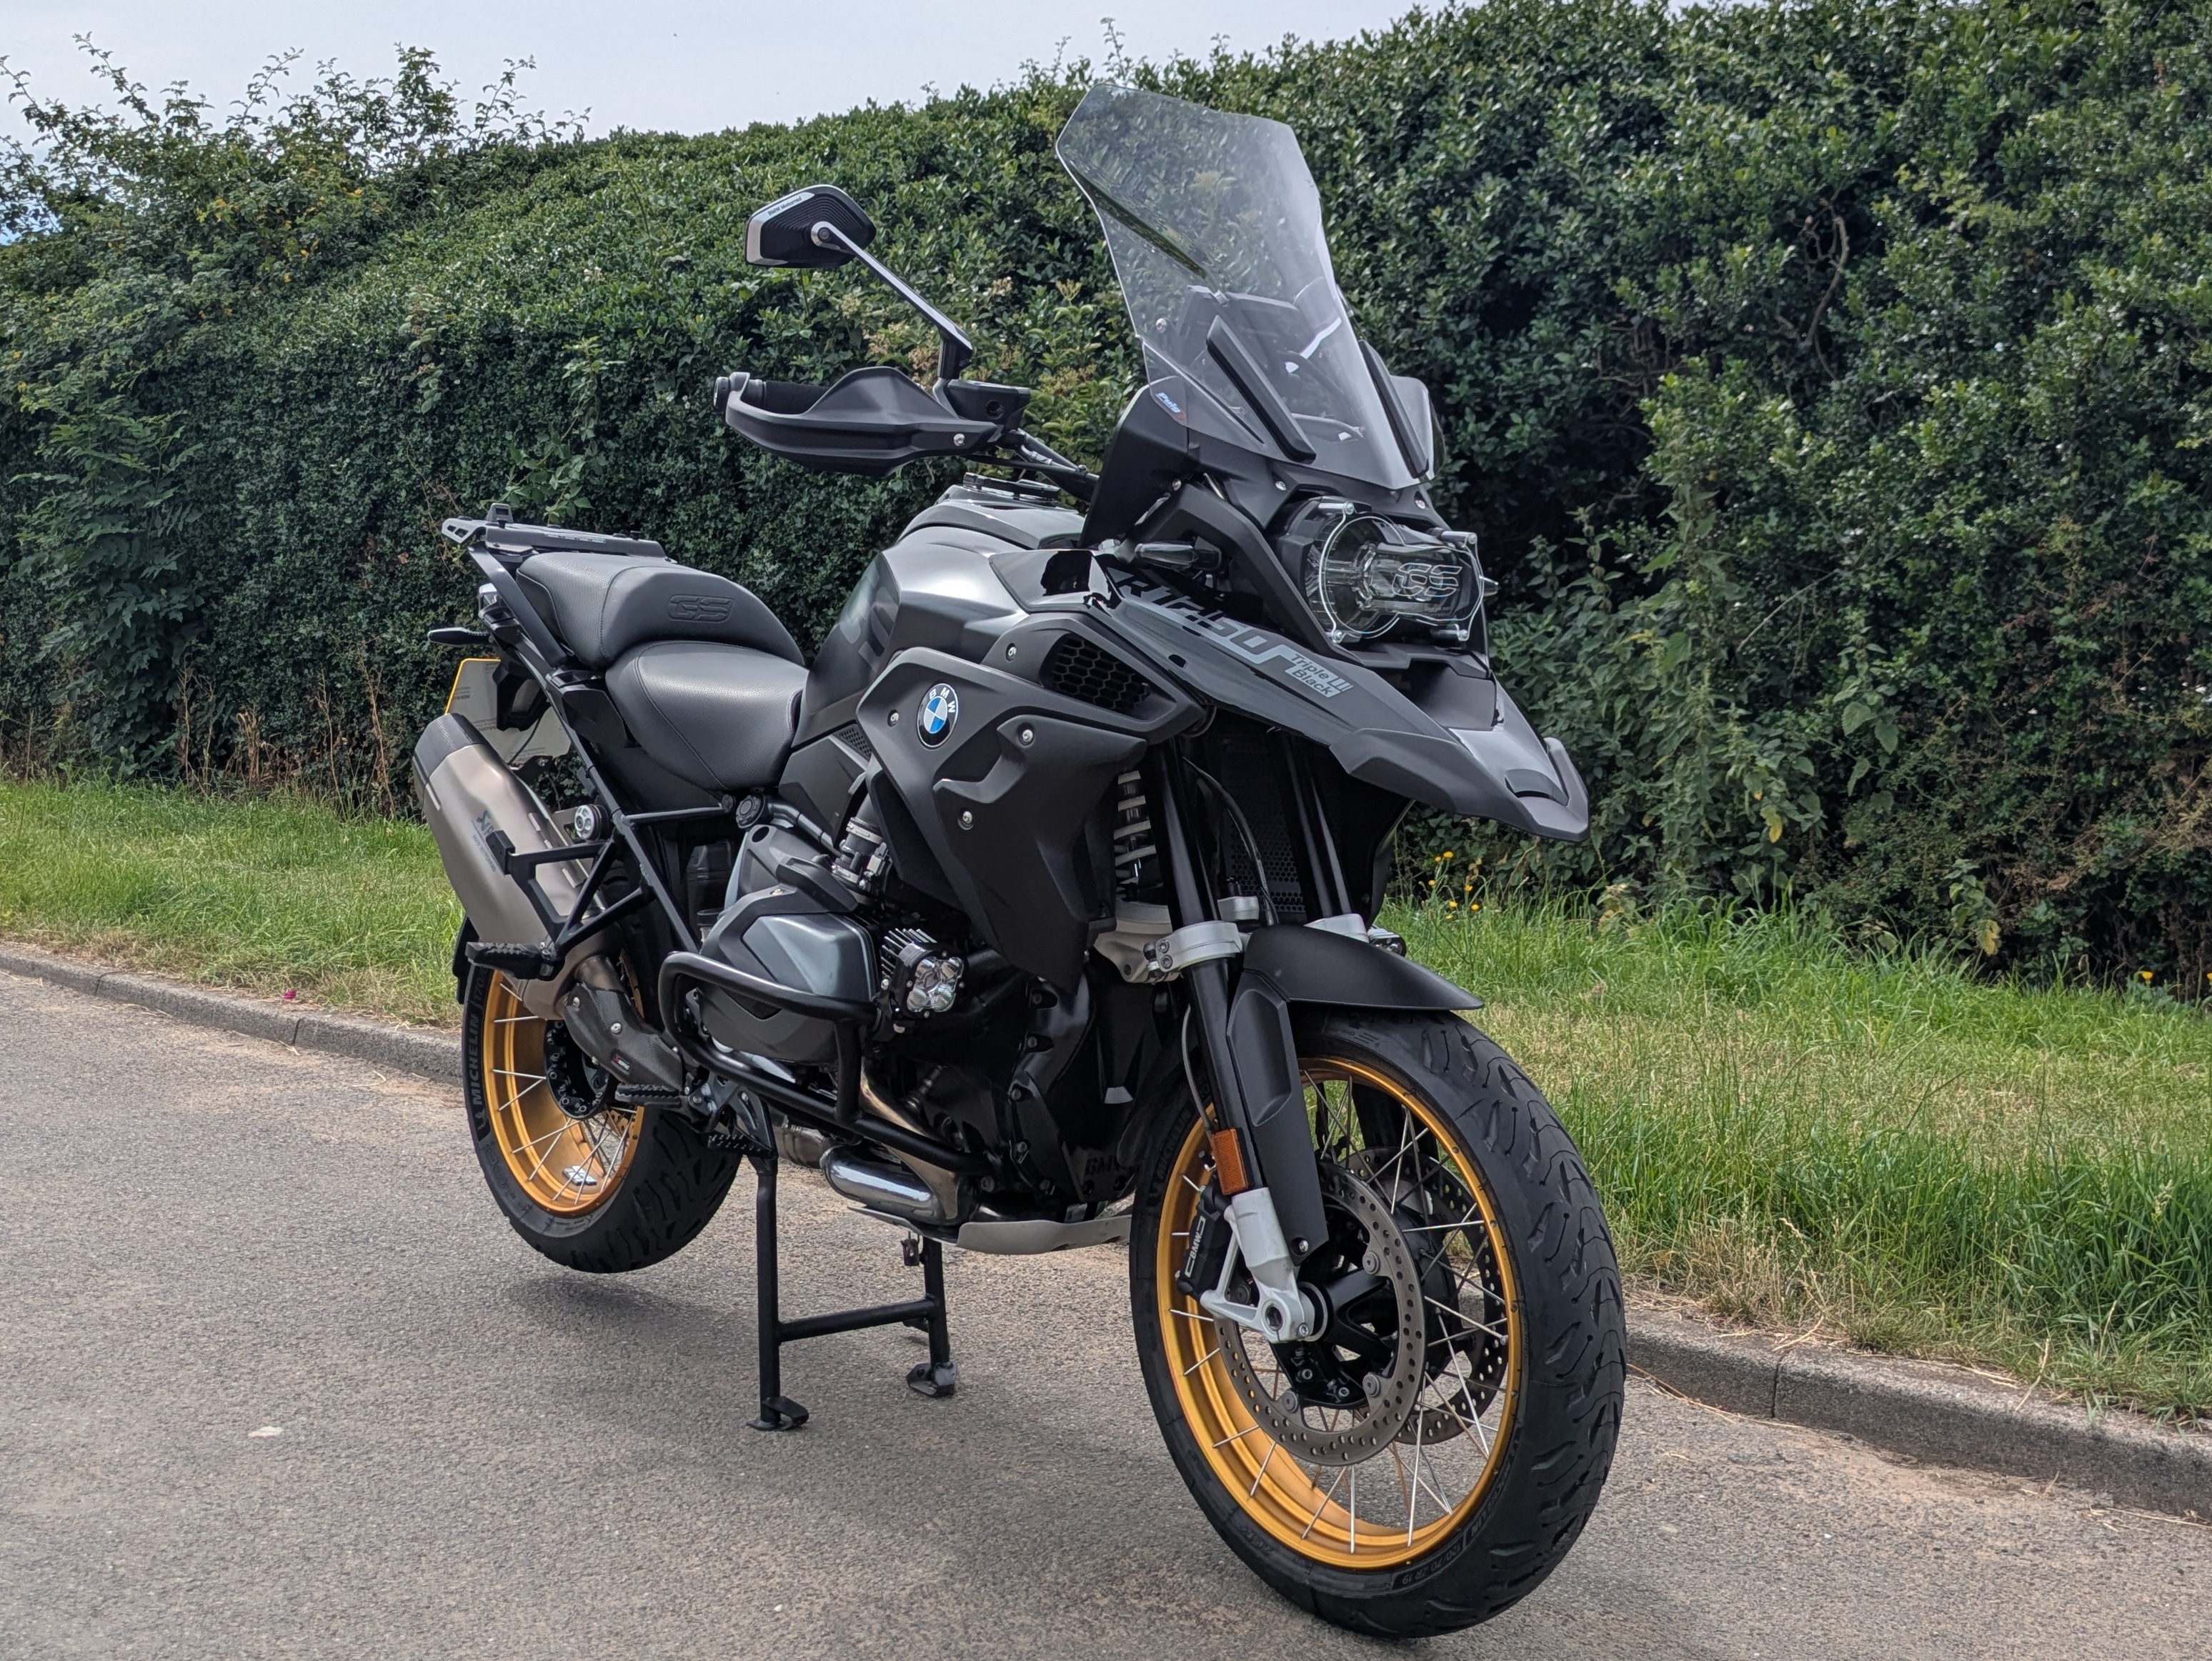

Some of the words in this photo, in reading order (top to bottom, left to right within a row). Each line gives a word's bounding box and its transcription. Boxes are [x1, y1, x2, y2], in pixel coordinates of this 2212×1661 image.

[1155, 392, 1181, 413] Puig
[1393, 562, 1463, 597] GS
[667, 593, 733, 623] GS
[1290, 653, 1330, 680] Triple
[1291, 668, 1333, 696] Black
[930, 687, 956, 713] BMW
[469, 1013, 483, 1105] MICHELIN
[1190, 1231, 1202, 1260] BMW
[1402, 1574, 1413, 1585] 19
